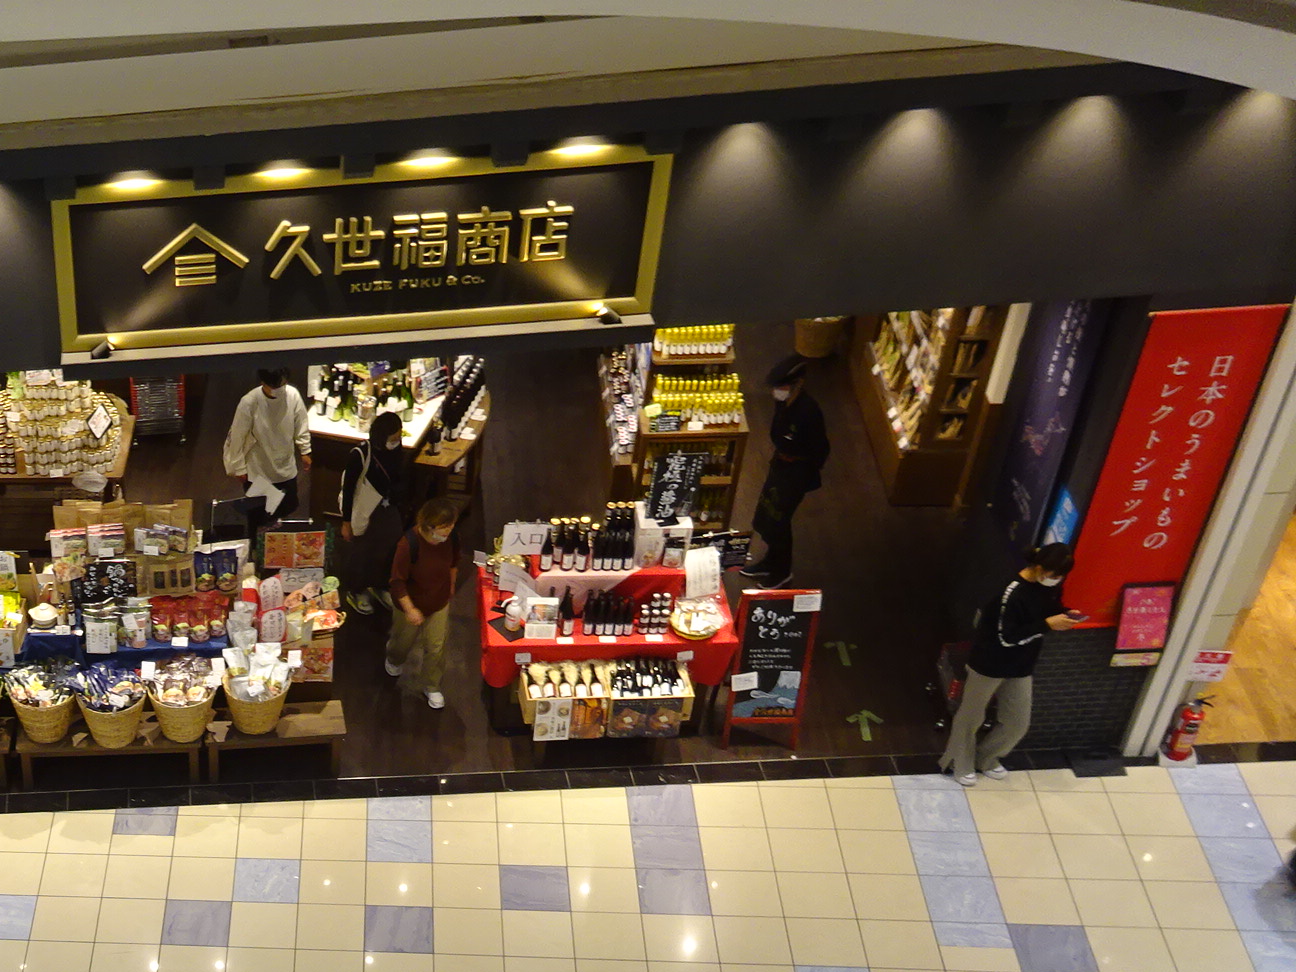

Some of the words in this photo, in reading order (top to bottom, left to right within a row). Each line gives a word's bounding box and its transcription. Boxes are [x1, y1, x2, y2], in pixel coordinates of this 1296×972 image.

[264, 201, 574, 280] 久世福商店
[350, 281, 393, 293] KUZE
[1109, 355, 1190, 537] セレクトショップ
[1143, 354, 1235, 550] 日本のうまいもの
[510, 532, 544, 546] 入口
